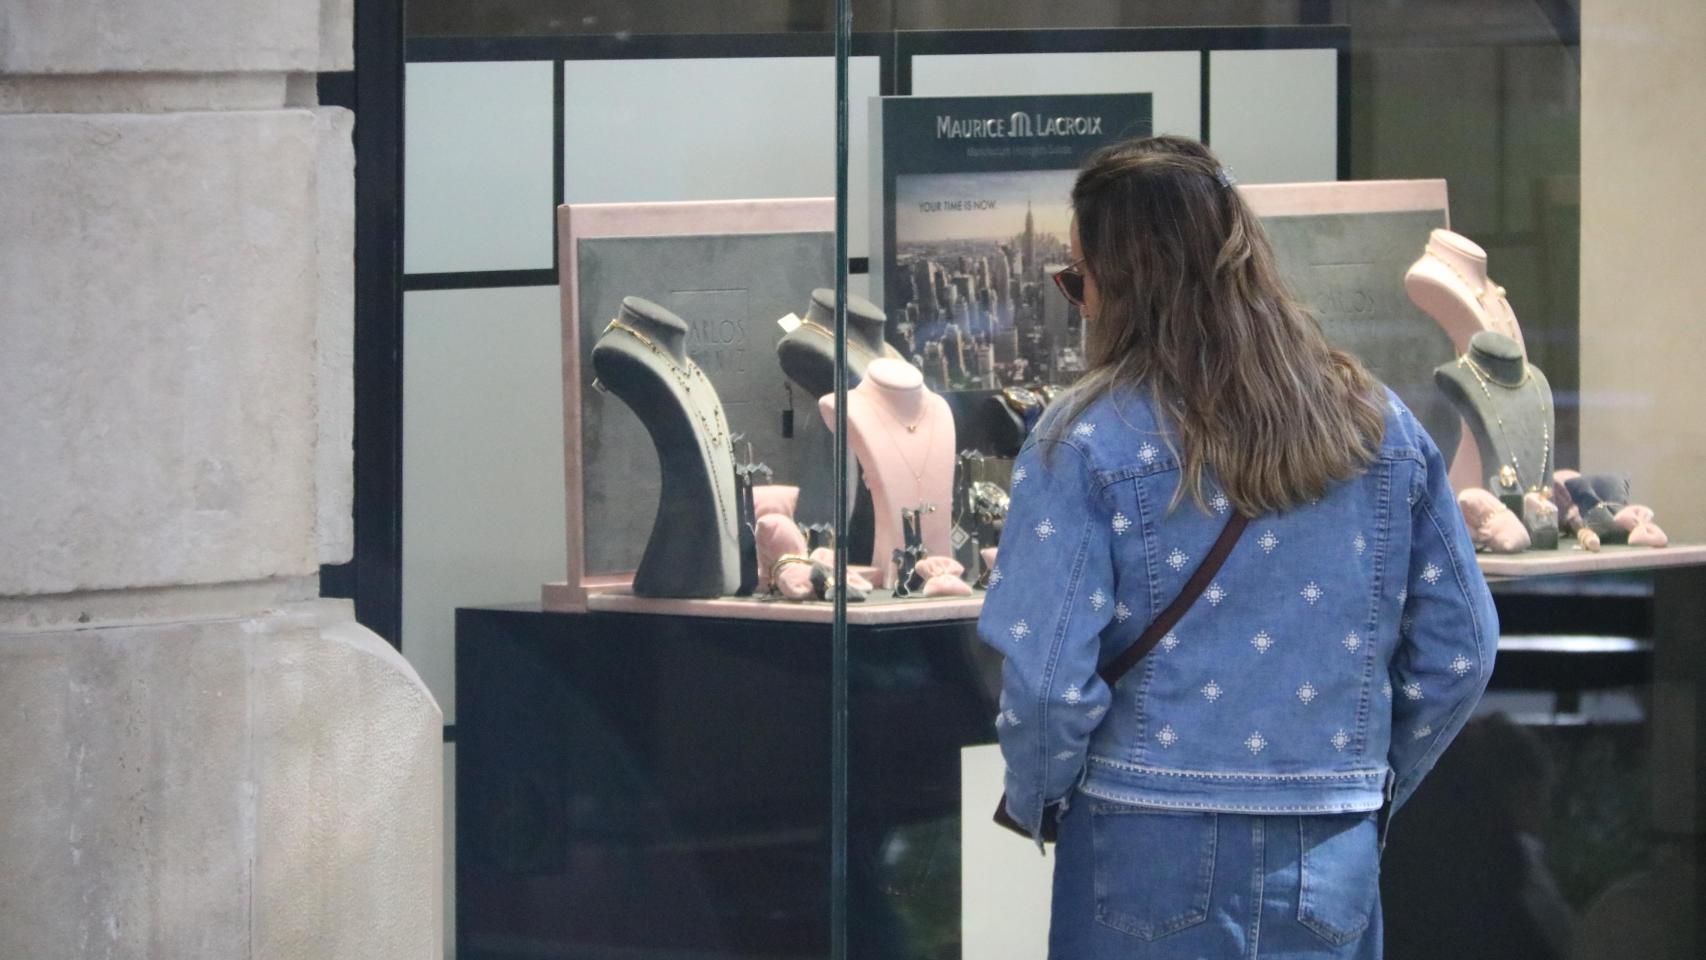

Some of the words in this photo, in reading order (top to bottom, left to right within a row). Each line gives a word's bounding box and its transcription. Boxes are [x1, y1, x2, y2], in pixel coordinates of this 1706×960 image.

[936, 115, 1005, 139] MAURICE
[1036, 113, 1103, 137] LACROIX
[919, 201, 942, 212] YOUR
[943, 200, 962, 211] TIME
[964, 200, 972, 211] IS
[684, 319, 745, 344] ARLOS
